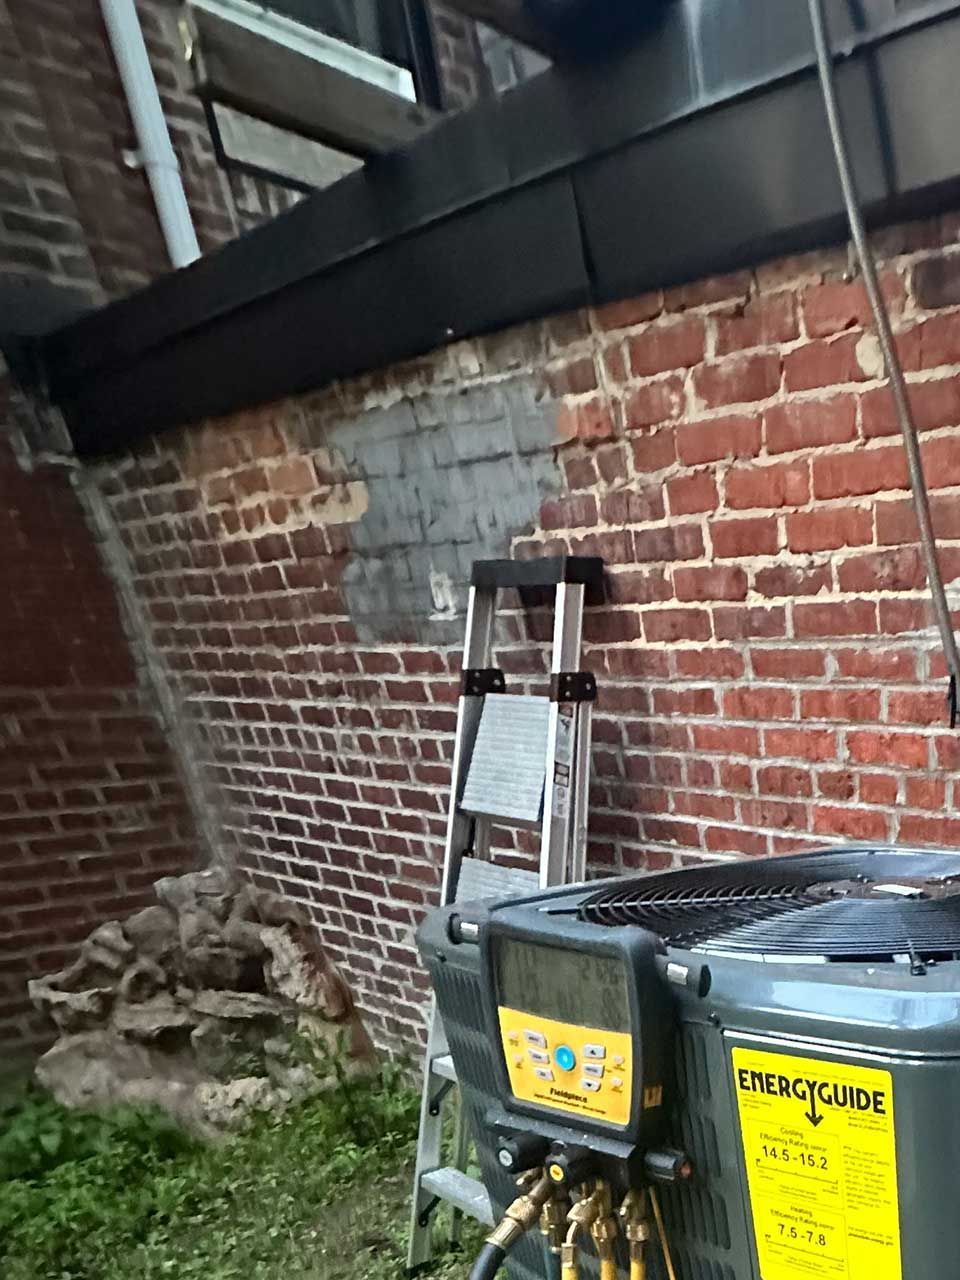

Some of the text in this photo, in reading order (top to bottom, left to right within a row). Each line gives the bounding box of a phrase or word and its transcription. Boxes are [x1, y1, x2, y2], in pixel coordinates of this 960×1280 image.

[549, 1088, 588, 1103] Fieldpiece
[738, 1069, 887, 1115] ENERGYGUIDE
[780, 1127, 804, 1139] Cooling
[760, 1133, 788, 1146] Efficiency
[789, 1138, 809, 1150] Rating
[770, 1209, 798, 1223] Efficiency
[799, 1216, 818, 1229] Rating
[790, 1205, 813, 1218] Heating
